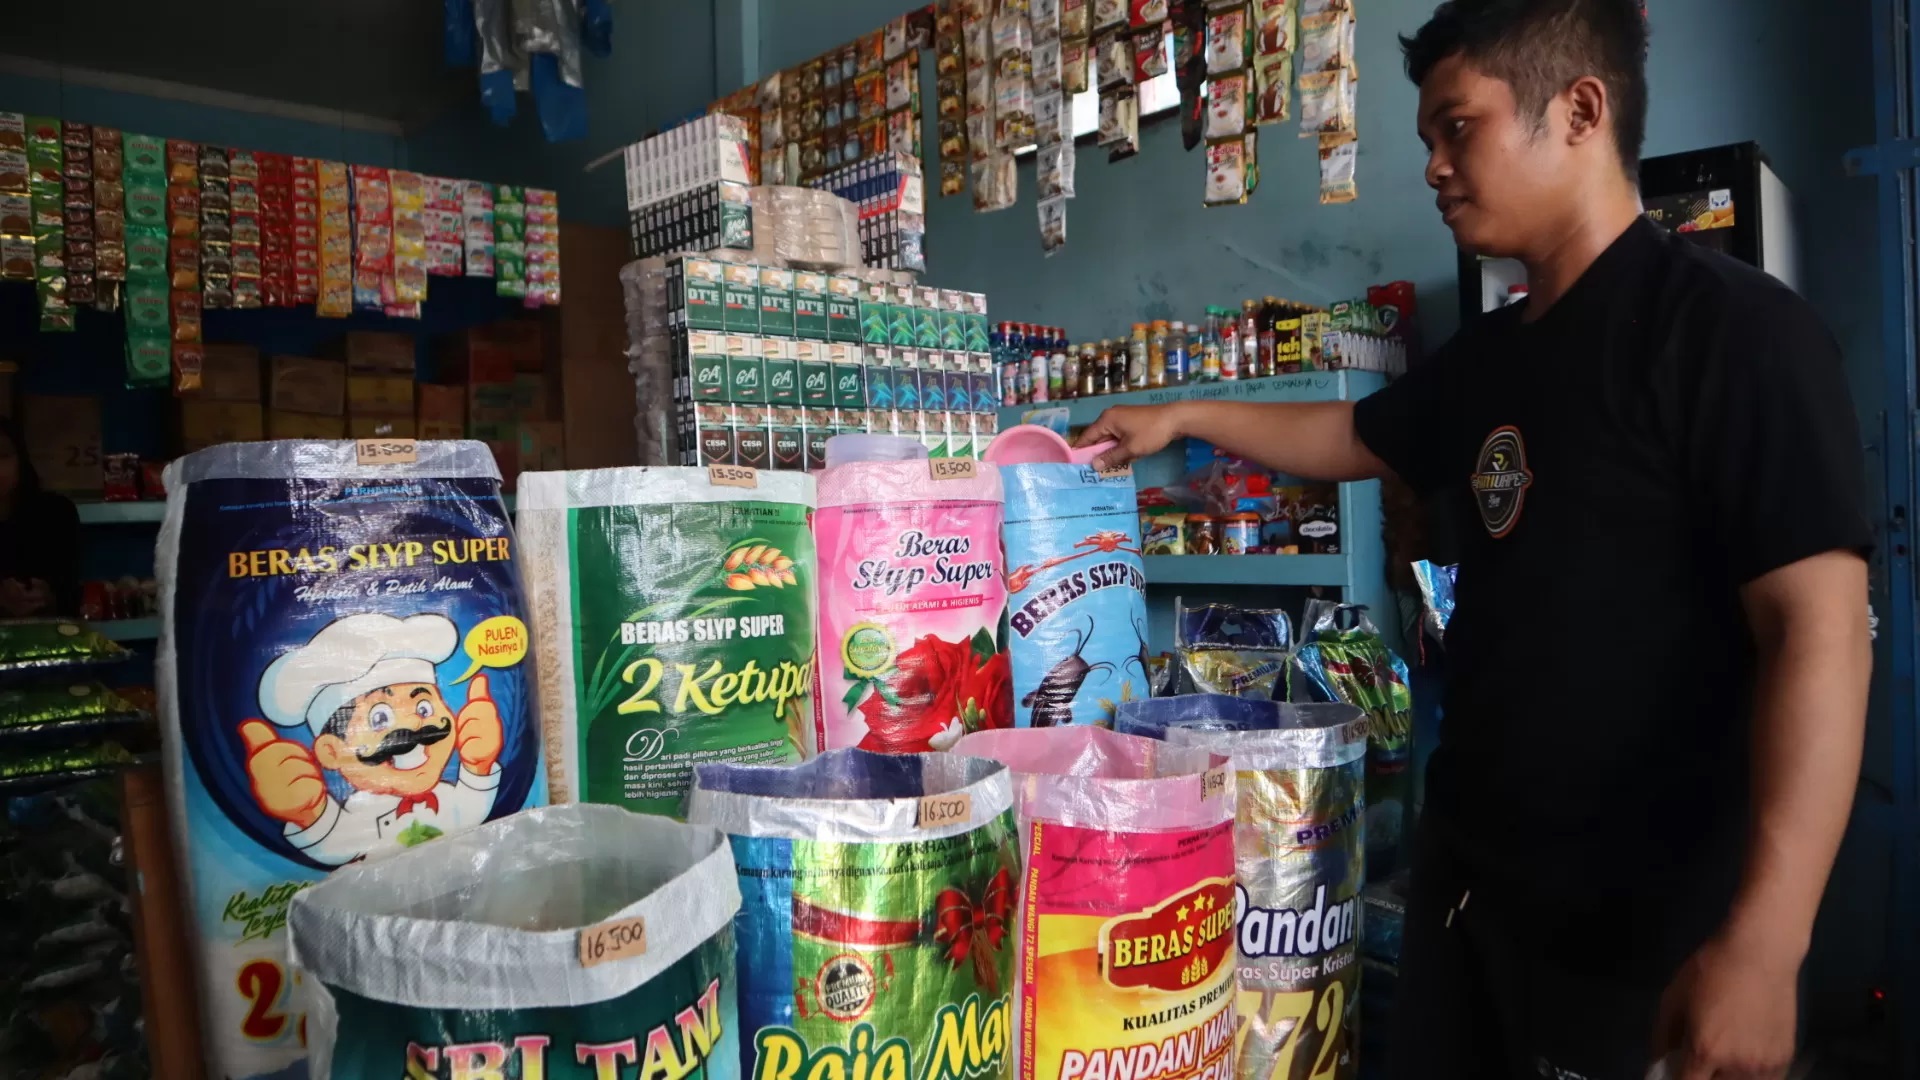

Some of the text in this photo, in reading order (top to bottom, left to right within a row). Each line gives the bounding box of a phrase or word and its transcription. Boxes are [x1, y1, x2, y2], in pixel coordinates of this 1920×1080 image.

[1277, 336, 1300, 354] teh
[360, 443, 414, 458] 15.500
[711, 468, 754, 481] 15.500
[936, 461, 971, 476] 15.500
[896, 531, 970, 559] Beras
[228, 537, 510, 579] BERAS SLYP SUPER
[385, 579, 426, 596] Putih
[432, 576, 474, 592] Alami
[854, 557, 992, 594] Slyp Super
[951, 597, 979, 606] HIGIENIS
[1010, 571, 1087, 639] BERAS
[1089, 562, 1129, 590] SLYP
[485, 627, 518, 642] PULEN
[621, 614, 784, 645] BERAS SLYP SUPER
[617, 658, 663, 715] 2
[1232, 662, 1280, 687] PREMIUM
[673, 752, 690, 760] padi
[693, 750, 717, 759] pilihan
[720, 747, 736, 757] yang
[641, 772, 677, 781] diproses
[645, 763, 683, 771] pertanian
[668, 779, 690, 788] sehin
[923, 803, 965, 822] 16.500
[1032, 822, 1042, 856] PESCIAL
[243, 905, 287, 939] Terja
[1025, 867, 1038, 984] PANDAN WANGI 72 SPESCIAL
[587, 922, 643, 959] 16.500
[1114, 925, 1194, 968] BERAS
[1236, 967, 1262, 979] ras
[1268, 962, 1320, 981] Super
[826, 983, 873, 1008] QUALITY
[1123, 1000, 1196, 1031] KUALITAS
[1024, 996, 1033, 1071] PANDAN WANGI 72
[1061, 1032, 1197, 1080] PANDAN
